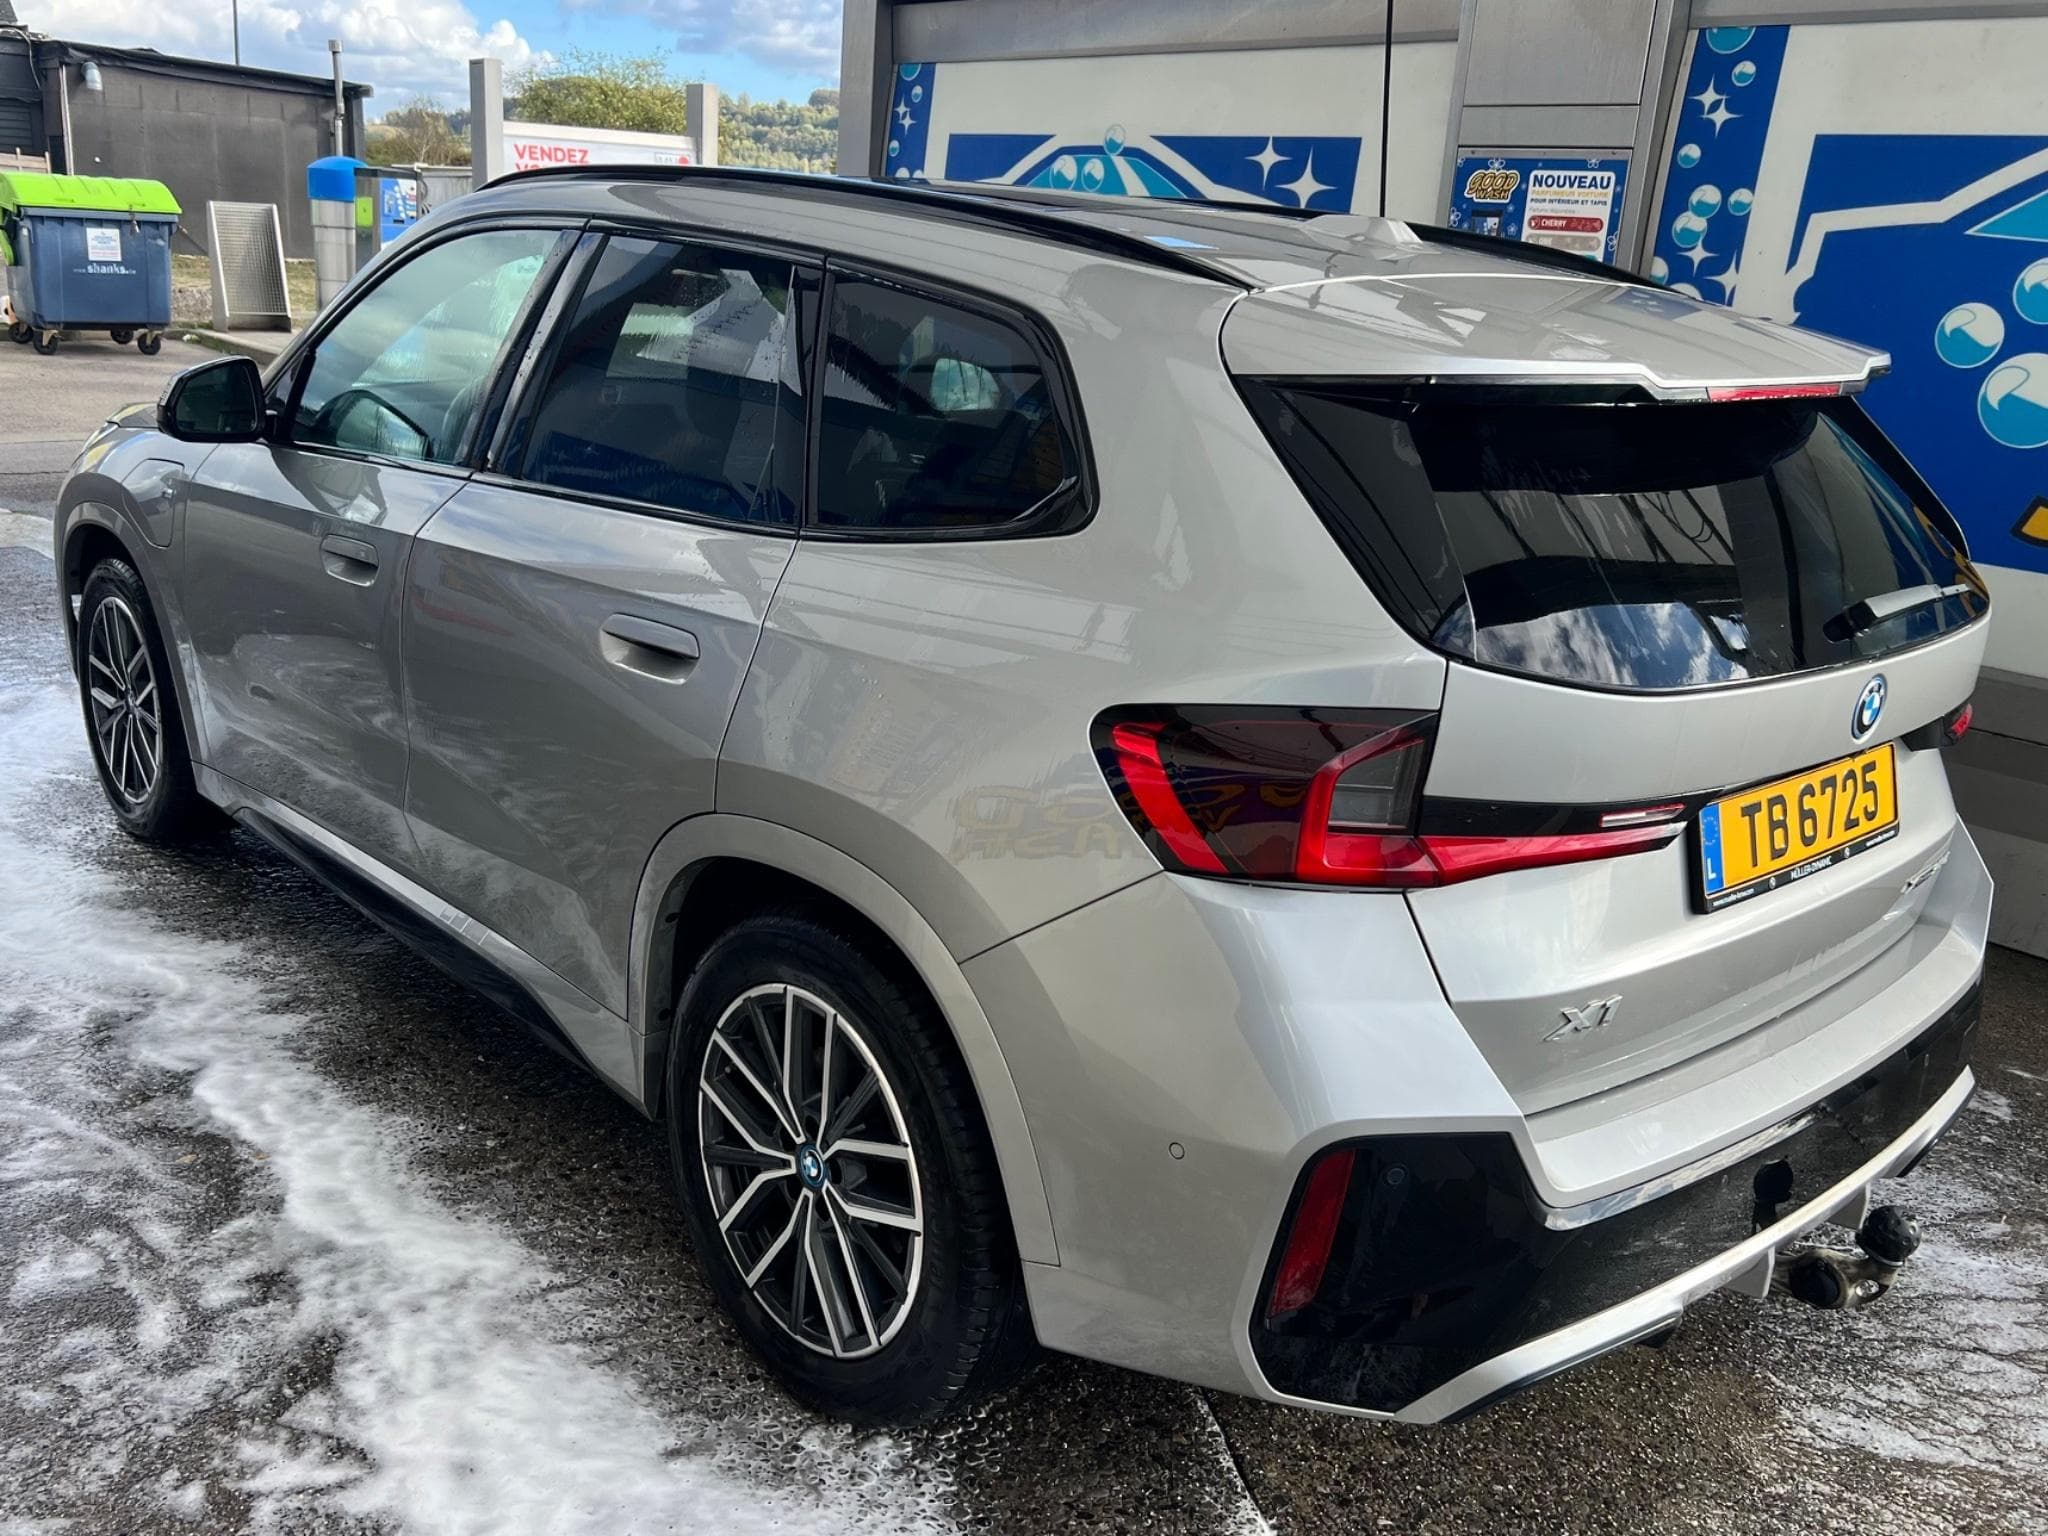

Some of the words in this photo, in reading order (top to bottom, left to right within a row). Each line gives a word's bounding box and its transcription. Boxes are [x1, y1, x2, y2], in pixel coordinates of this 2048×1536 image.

[514, 143, 589, 164] VENDEZ
[1467, 172, 1518, 194] GOOD
[1533, 174, 1611, 189] NOUVEAU
[1476, 188, 1509, 199] WASH
[1541, 218, 1567, 228] CHERRY
[1706, 857, 1716, 880] L
[1543, 994, 1623, 1041] X1
